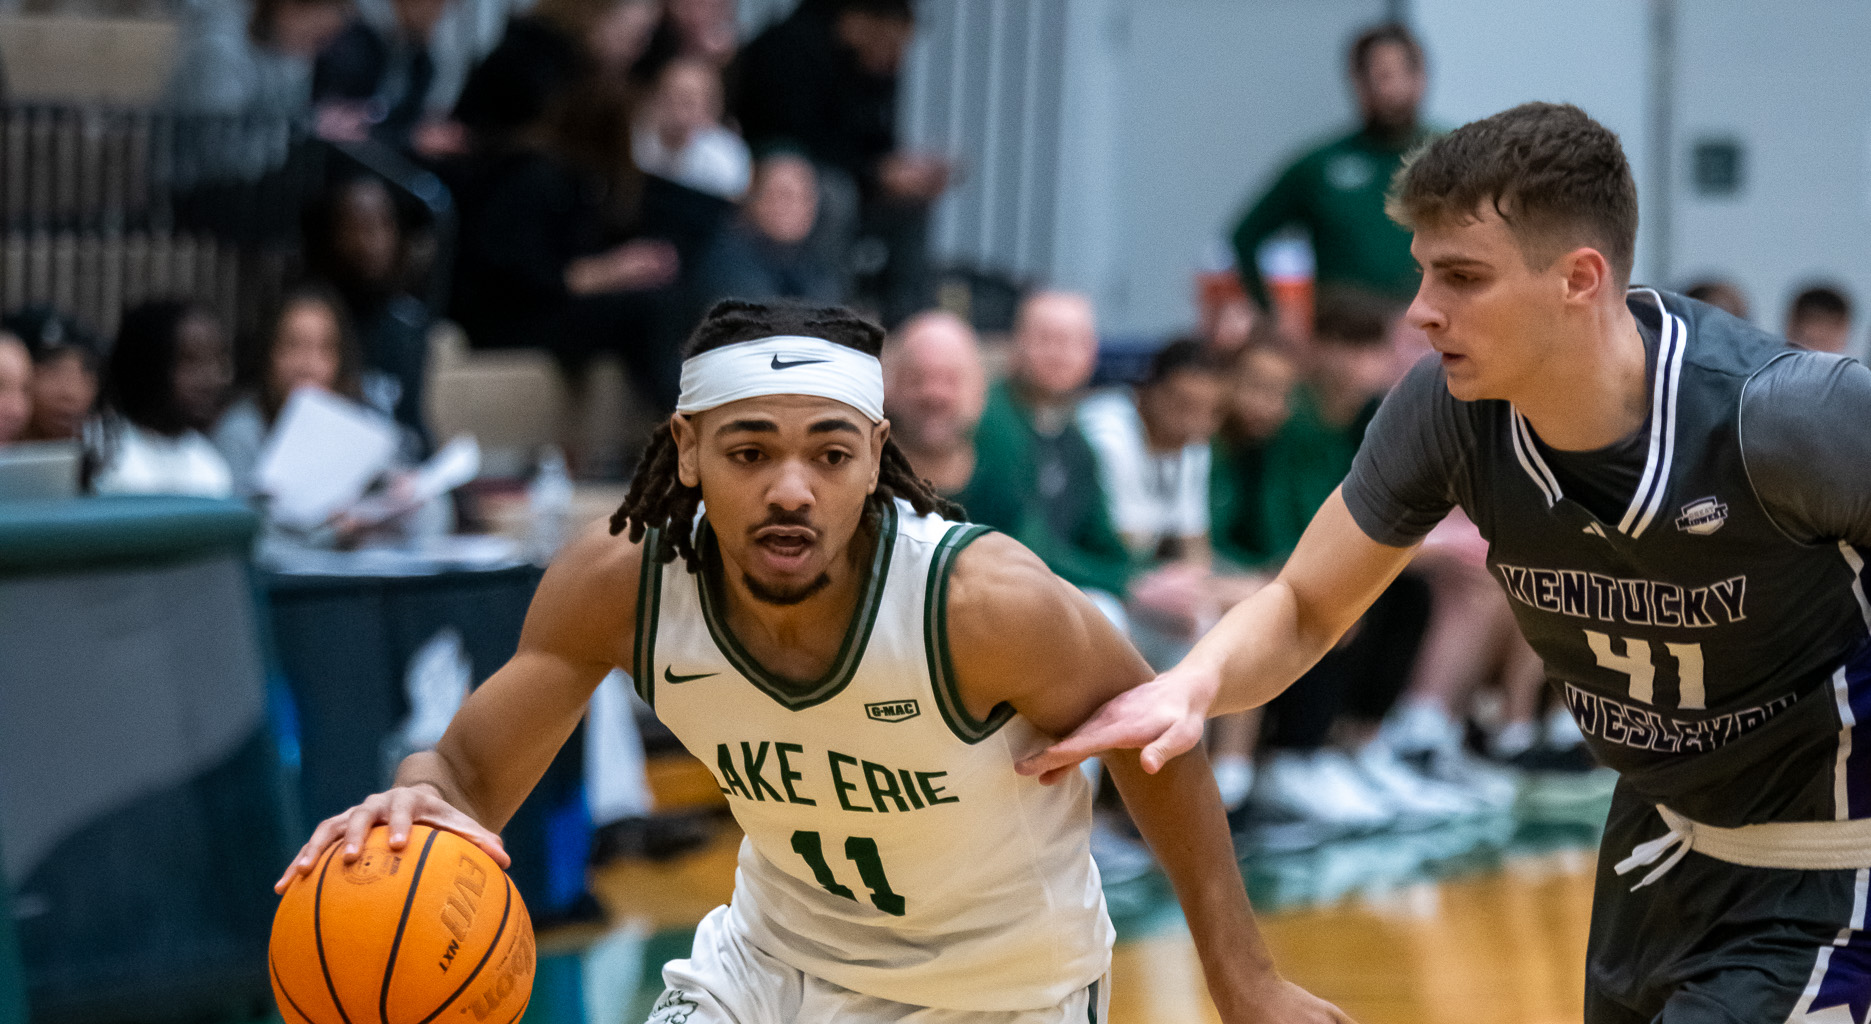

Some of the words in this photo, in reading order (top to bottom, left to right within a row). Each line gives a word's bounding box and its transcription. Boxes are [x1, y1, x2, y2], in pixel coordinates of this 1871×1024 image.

[1676, 503, 1728, 531] MIDWEST
[1498, 564, 1747, 628] KENTUCKY
[1582, 629, 1707, 710] 41
[871, 703, 915, 718] G-MAC
[827, 750, 960, 813] ERIE
[440, 852, 488, 943] EVO
[790, 830, 906, 917] 11
[438, 938, 461, 976] NXT
